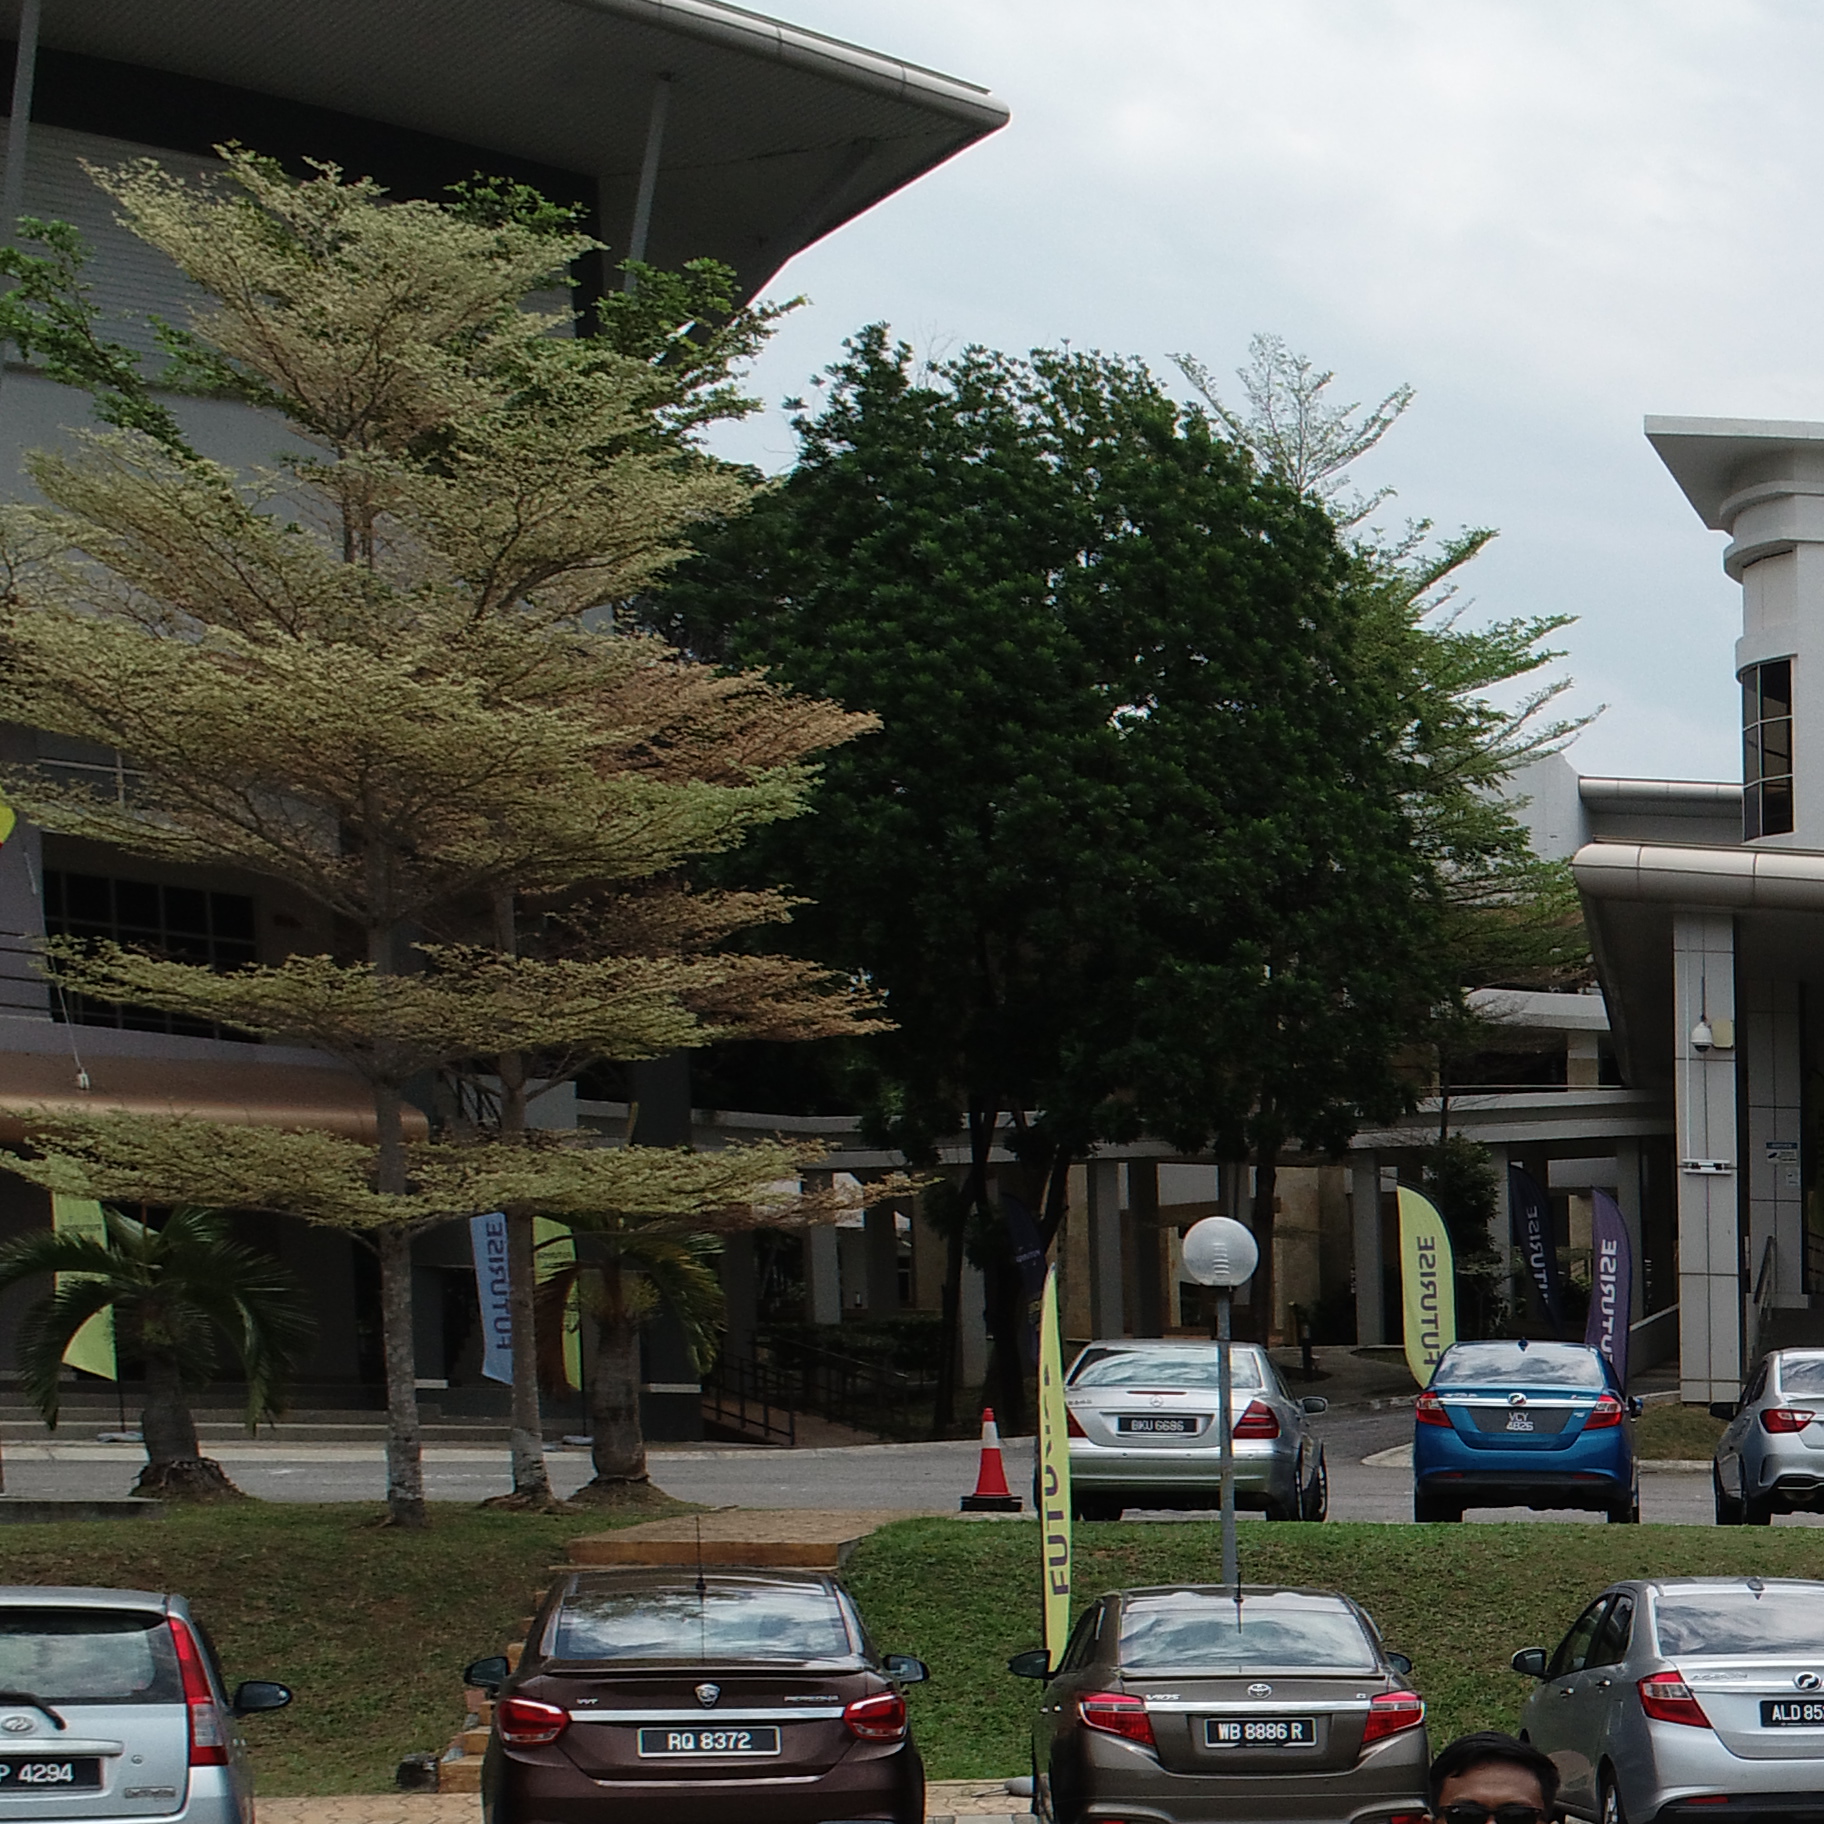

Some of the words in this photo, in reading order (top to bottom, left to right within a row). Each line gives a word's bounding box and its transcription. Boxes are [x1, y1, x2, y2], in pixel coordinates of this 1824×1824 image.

[1508, 1412, 1529, 1421] VCY
[1772, 1704, 1801, 1721] ALD
[1218, 1723, 1241, 1740] WB
[1244, 1723, 1288, 1740] 8886
[1291, 1722, 1304, 1740] R
[668, 1733, 695, 1750] RQ
[700, 1731, 752, 1749] 8372
[18, 1763, 74, 1782] 4294
